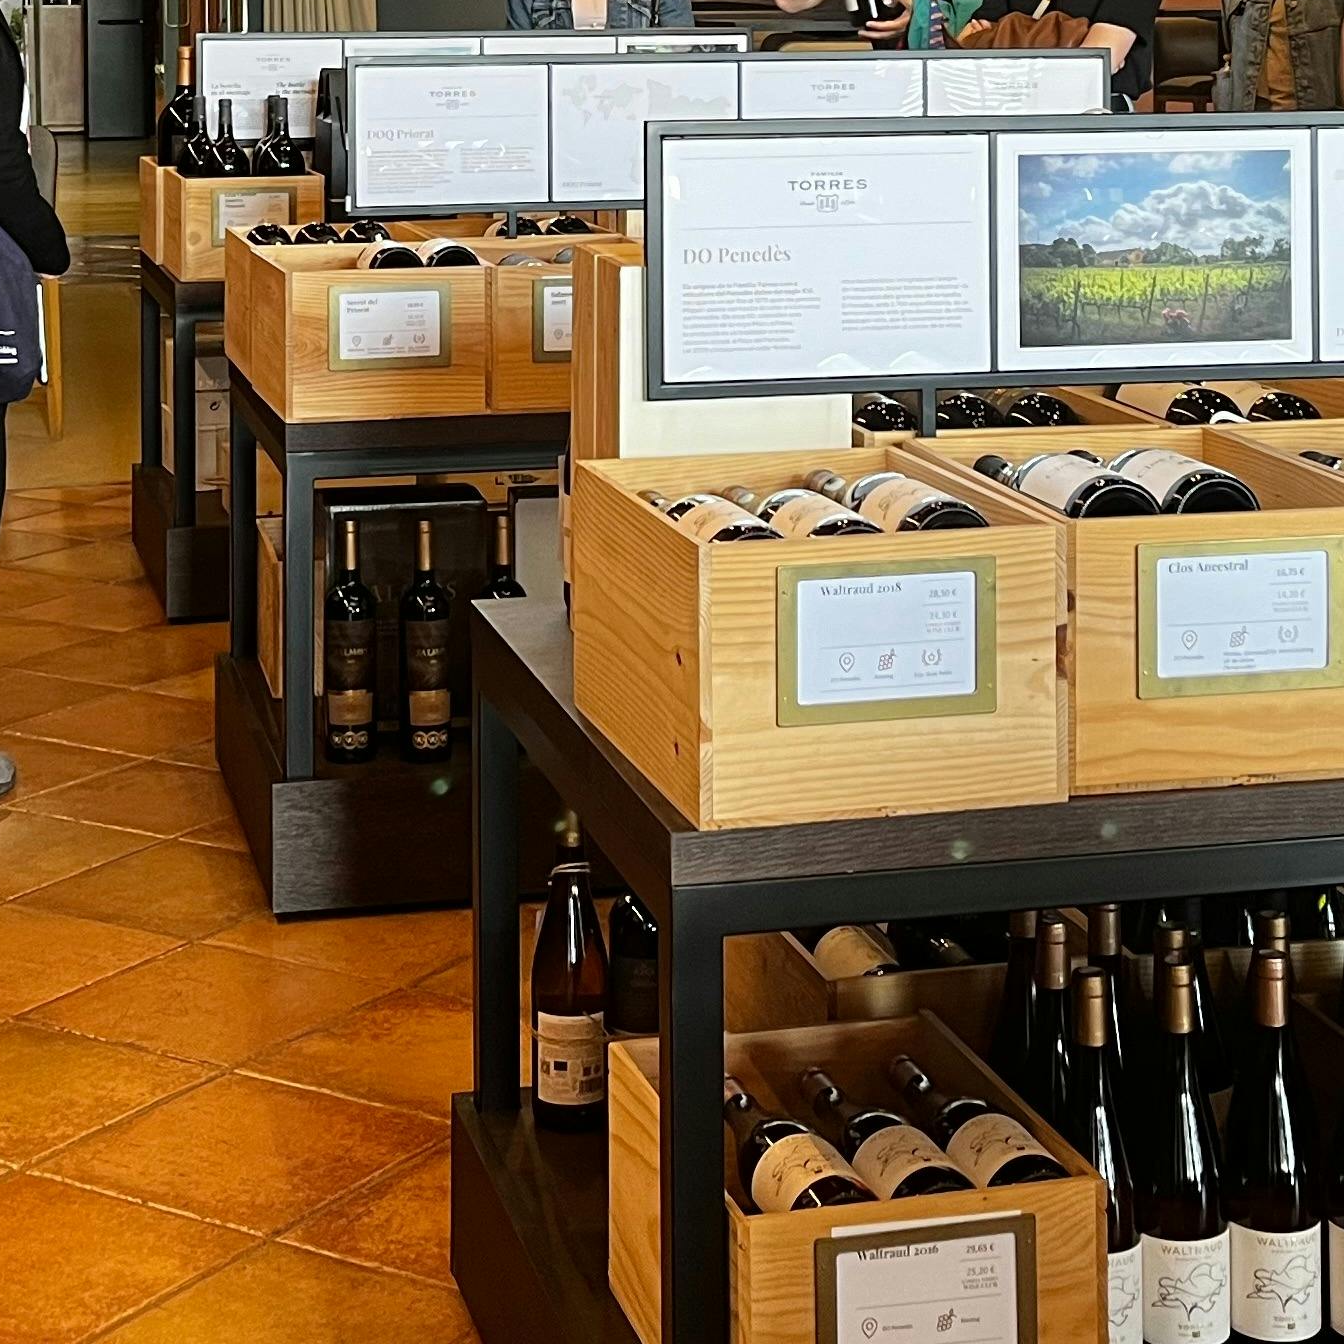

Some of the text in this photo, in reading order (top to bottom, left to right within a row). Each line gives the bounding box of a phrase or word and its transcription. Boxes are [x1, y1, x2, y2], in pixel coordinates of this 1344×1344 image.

[429, 90, 477, 98] TORRES
[367, 128, 435, 141] DOQ Priorat
[787, 178, 869, 192] TORRES
[683, 243, 792, 266] DO Penedès
[1168, 558, 1249, 573] Clos Ancestral
[820, 581, 903, 597] Waltraud 2018
[857, 1245, 911, 1261] Waltraud
[914, 1245, 940, 1257] 2016
